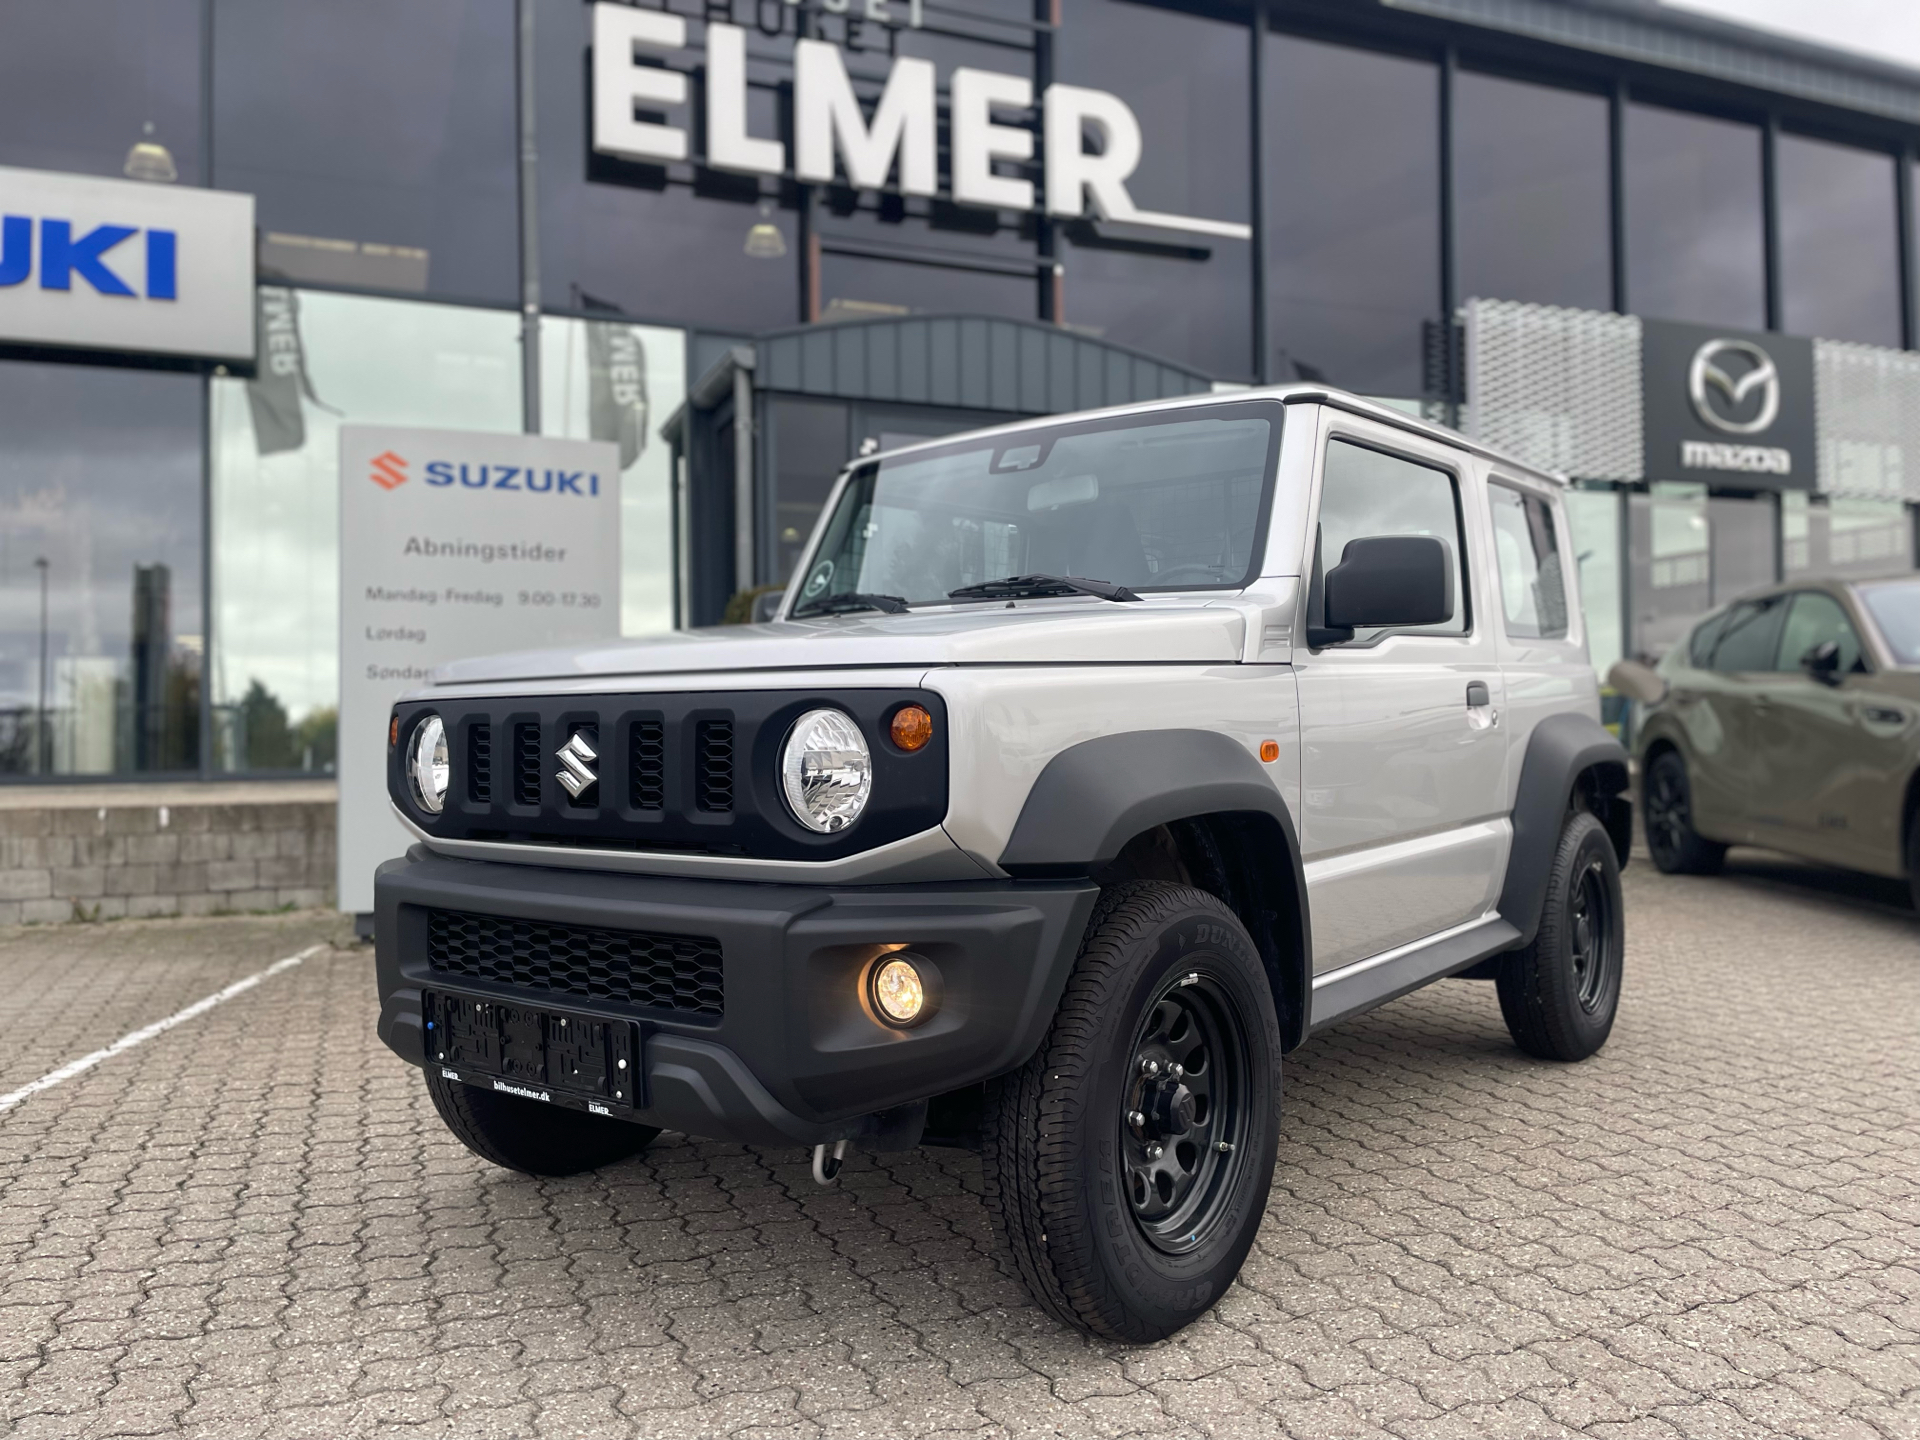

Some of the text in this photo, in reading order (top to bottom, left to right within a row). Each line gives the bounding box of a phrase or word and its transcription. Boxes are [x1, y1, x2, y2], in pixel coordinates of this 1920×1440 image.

[594, 2, 1251, 238] ELMER
[1682, 440, 1791, 475] mazda
[424, 459, 600, 496] SUZUKI
[442, 1070, 461, 1081] ELMER
[494, 1080, 550, 1102] bilhusetelmer.dk
[589, 1104, 613, 1117] ELMER
